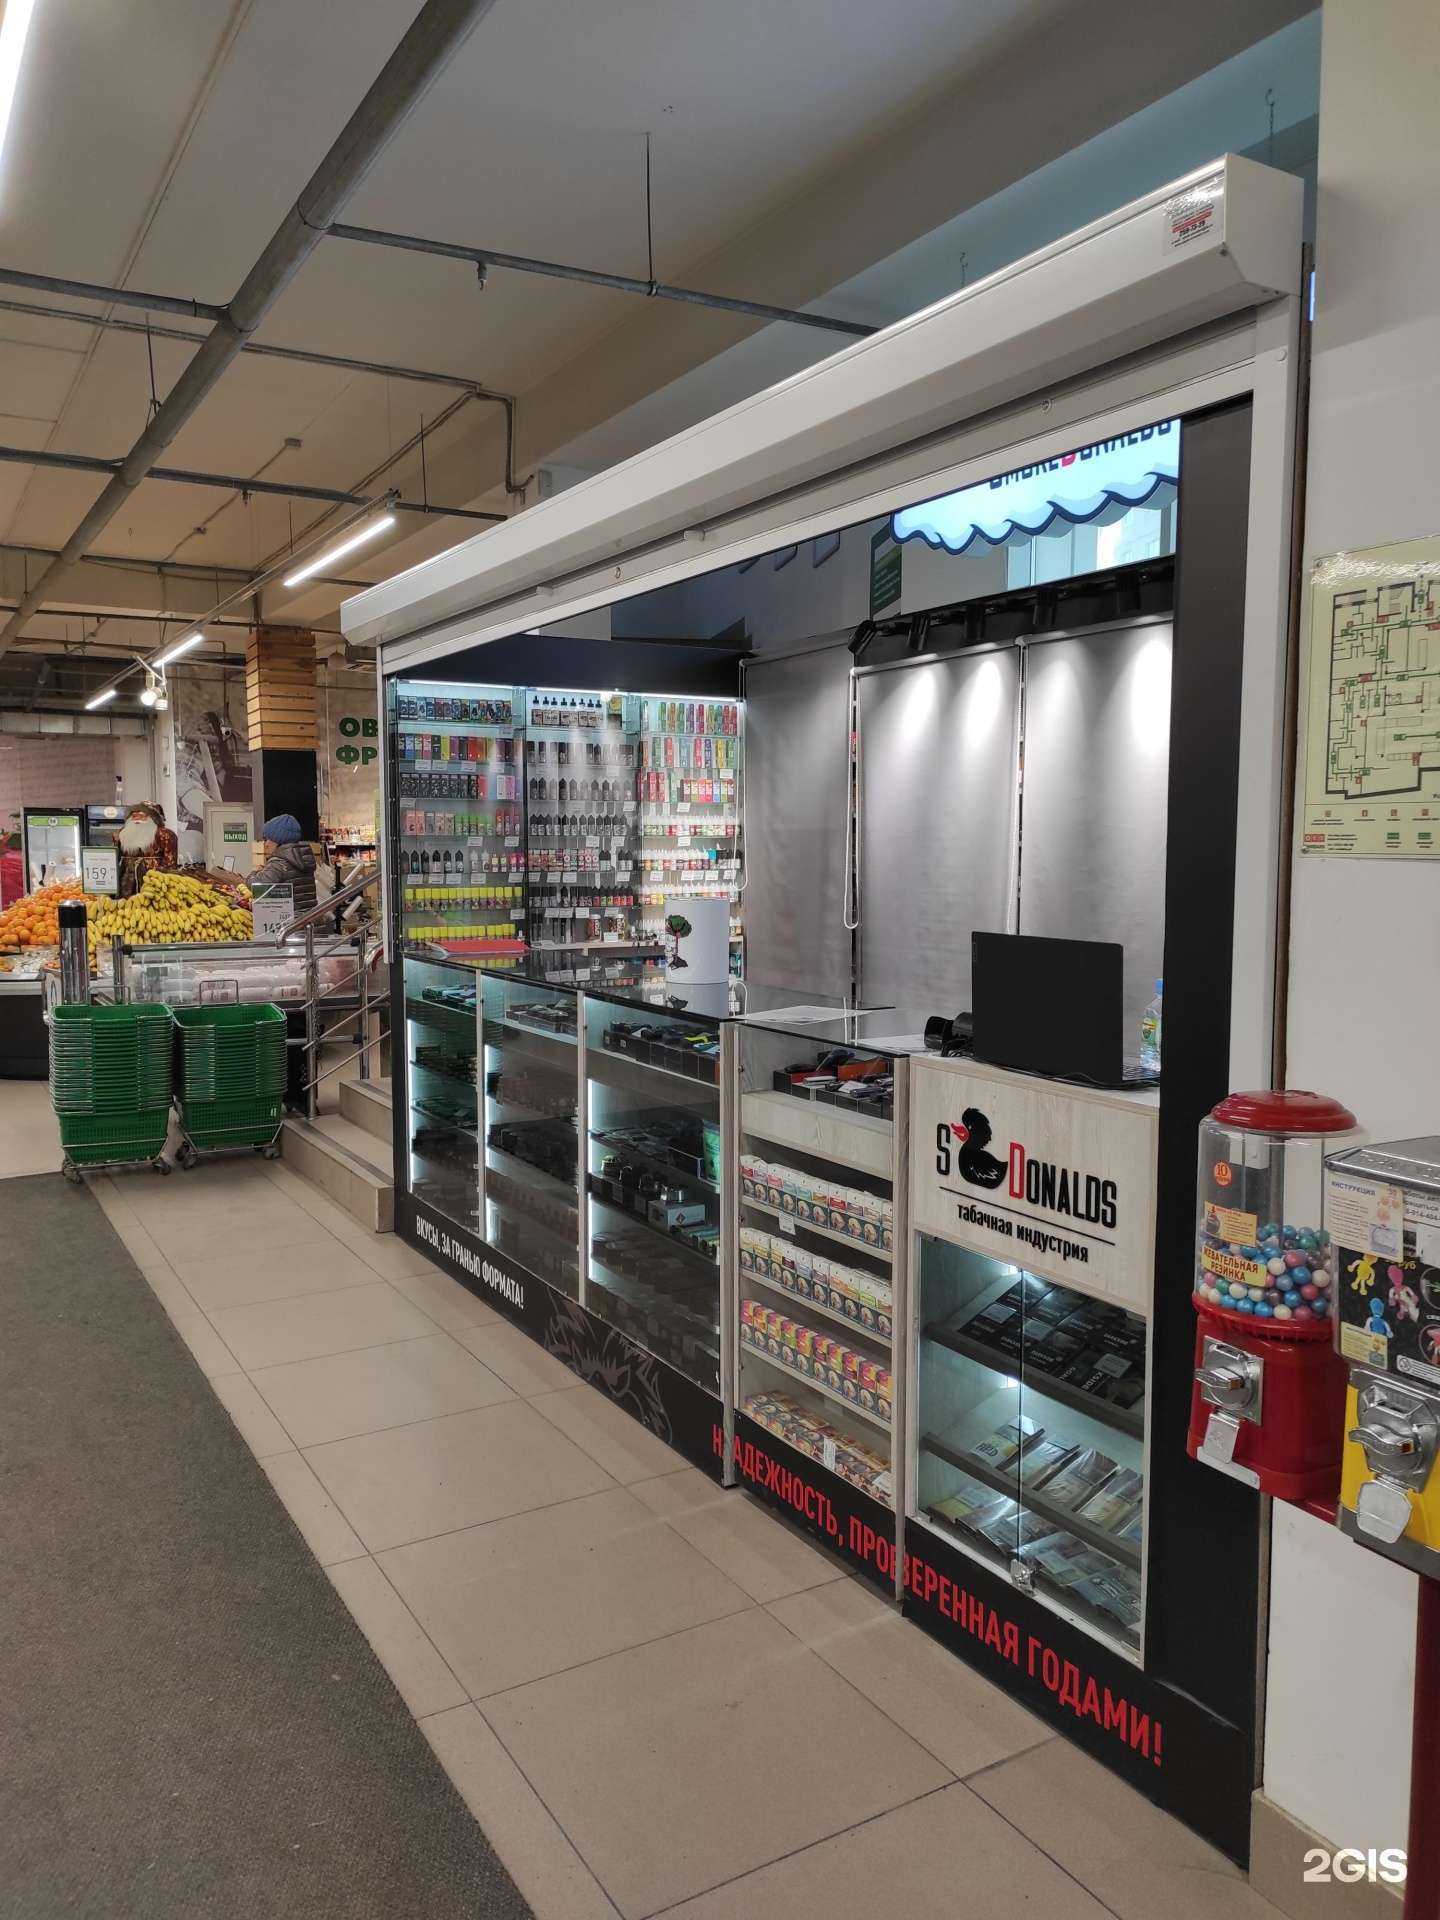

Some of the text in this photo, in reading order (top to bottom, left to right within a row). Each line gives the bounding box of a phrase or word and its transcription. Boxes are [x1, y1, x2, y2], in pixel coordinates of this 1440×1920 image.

[339, 717, 378, 737] ОВ
[336, 744, 378, 765] ФР
[224, 833, 247, 841] ВЫХОД
[86, 866, 107, 880] 159
[1008, 1141, 1117, 1229] DONALDS
[957, 1204, 1089, 1263] табачная индустрия
[416, 1215, 524, 1310] ВКУСЫ, ЗА ГРАНЬЮ ФОРМАТА!
[1210, 1261, 1246, 1282] РЕЗИНКА
[1028, 1635, 1165, 1768] ГОДАМИ!
